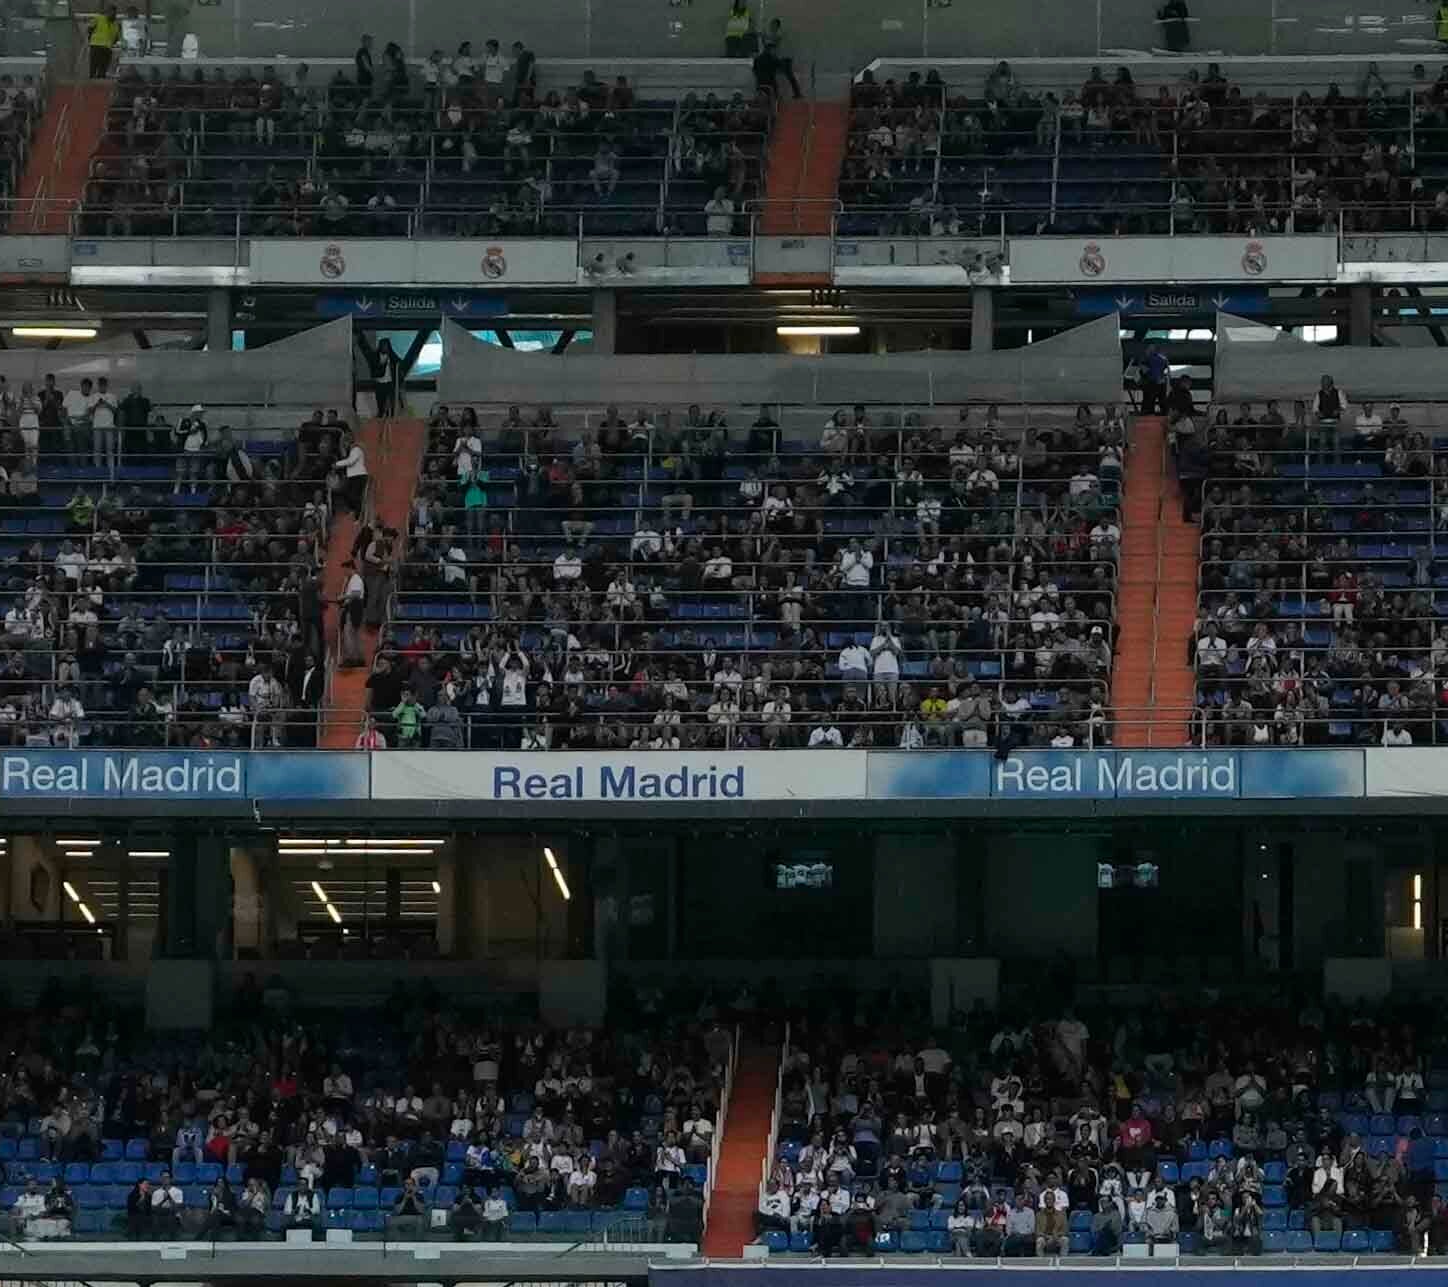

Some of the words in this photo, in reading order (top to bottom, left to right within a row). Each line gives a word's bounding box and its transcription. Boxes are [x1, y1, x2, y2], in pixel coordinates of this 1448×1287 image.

[388, 296, 435, 309] Salida
[1149, 293, 1195, 306] Salida
[4, 757, 87, 790] Real
[105, 757, 239, 792] Madrid
[493, 767, 584, 800] Real
[600, 764, 744, 800] Madrid
[998, 757, 1081, 791] Real
[1098, 757, 1233, 790] Madrid
